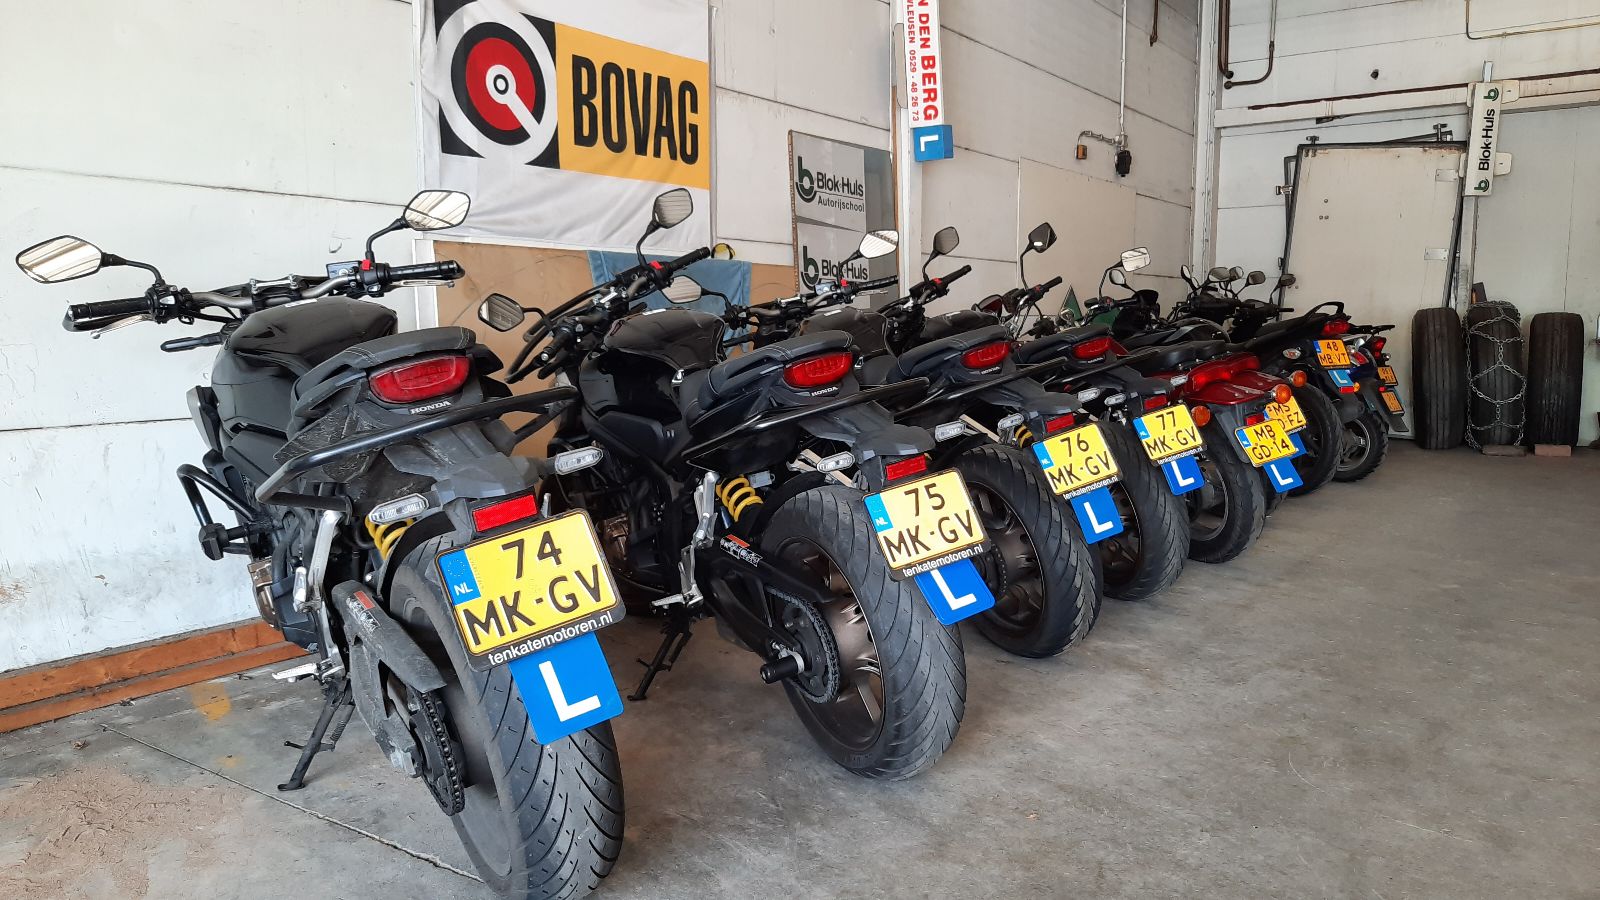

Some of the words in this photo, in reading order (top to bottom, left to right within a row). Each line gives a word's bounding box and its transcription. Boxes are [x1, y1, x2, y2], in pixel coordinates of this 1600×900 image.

[919, 13, 931, 49] DEN
[909, 50, 917, 73] 0529
[911, 82, 918, 93] 48
[921, 55, 939, 121] BERG
[572, 54, 699, 165] BOVAG
[912, 96, 919, 107] 26
[912, 110, 920, 122] 73
[919, 134, 939, 152] L
[817, 195, 865, 213] Autorijschool
[1326, 341, 1339, 352] 48
[1333, 370, 1348, 384] L
[811, 386, 839, 397] HONDA
[410, 400, 452, 415] HONDA
[1155, 410, 1176, 431] 77
[1060, 432, 1090, 458] 76
[1144, 425, 1197, 457] MK-GV
[1253, 424, 1276, 442] MB
[1251, 438, 1291, 461] GD-14
[1047, 450, 1111, 490] MK-GV
[1170, 460, 1195, 487] L
[1269, 463, 1294, 486] L
[903, 482, 946, 518] 75
[1062, 475, 1119, 501] tenkatemotoren.nl
[875, 516, 889, 527] NL
[1083, 501, 1114, 535] L
[882, 509, 974, 563] MK-GV
[501, 530, 563, 580] 74
[902, 543, 984, 578] tenkatemotoren.nl
[454, 582, 474, 597] NL
[930, 569, 977, 611] L
[462, 563, 603, 647] MK-GV
[488, 610, 614, 666] tenkatemotoren.nl
[538, 660, 602, 723] L
